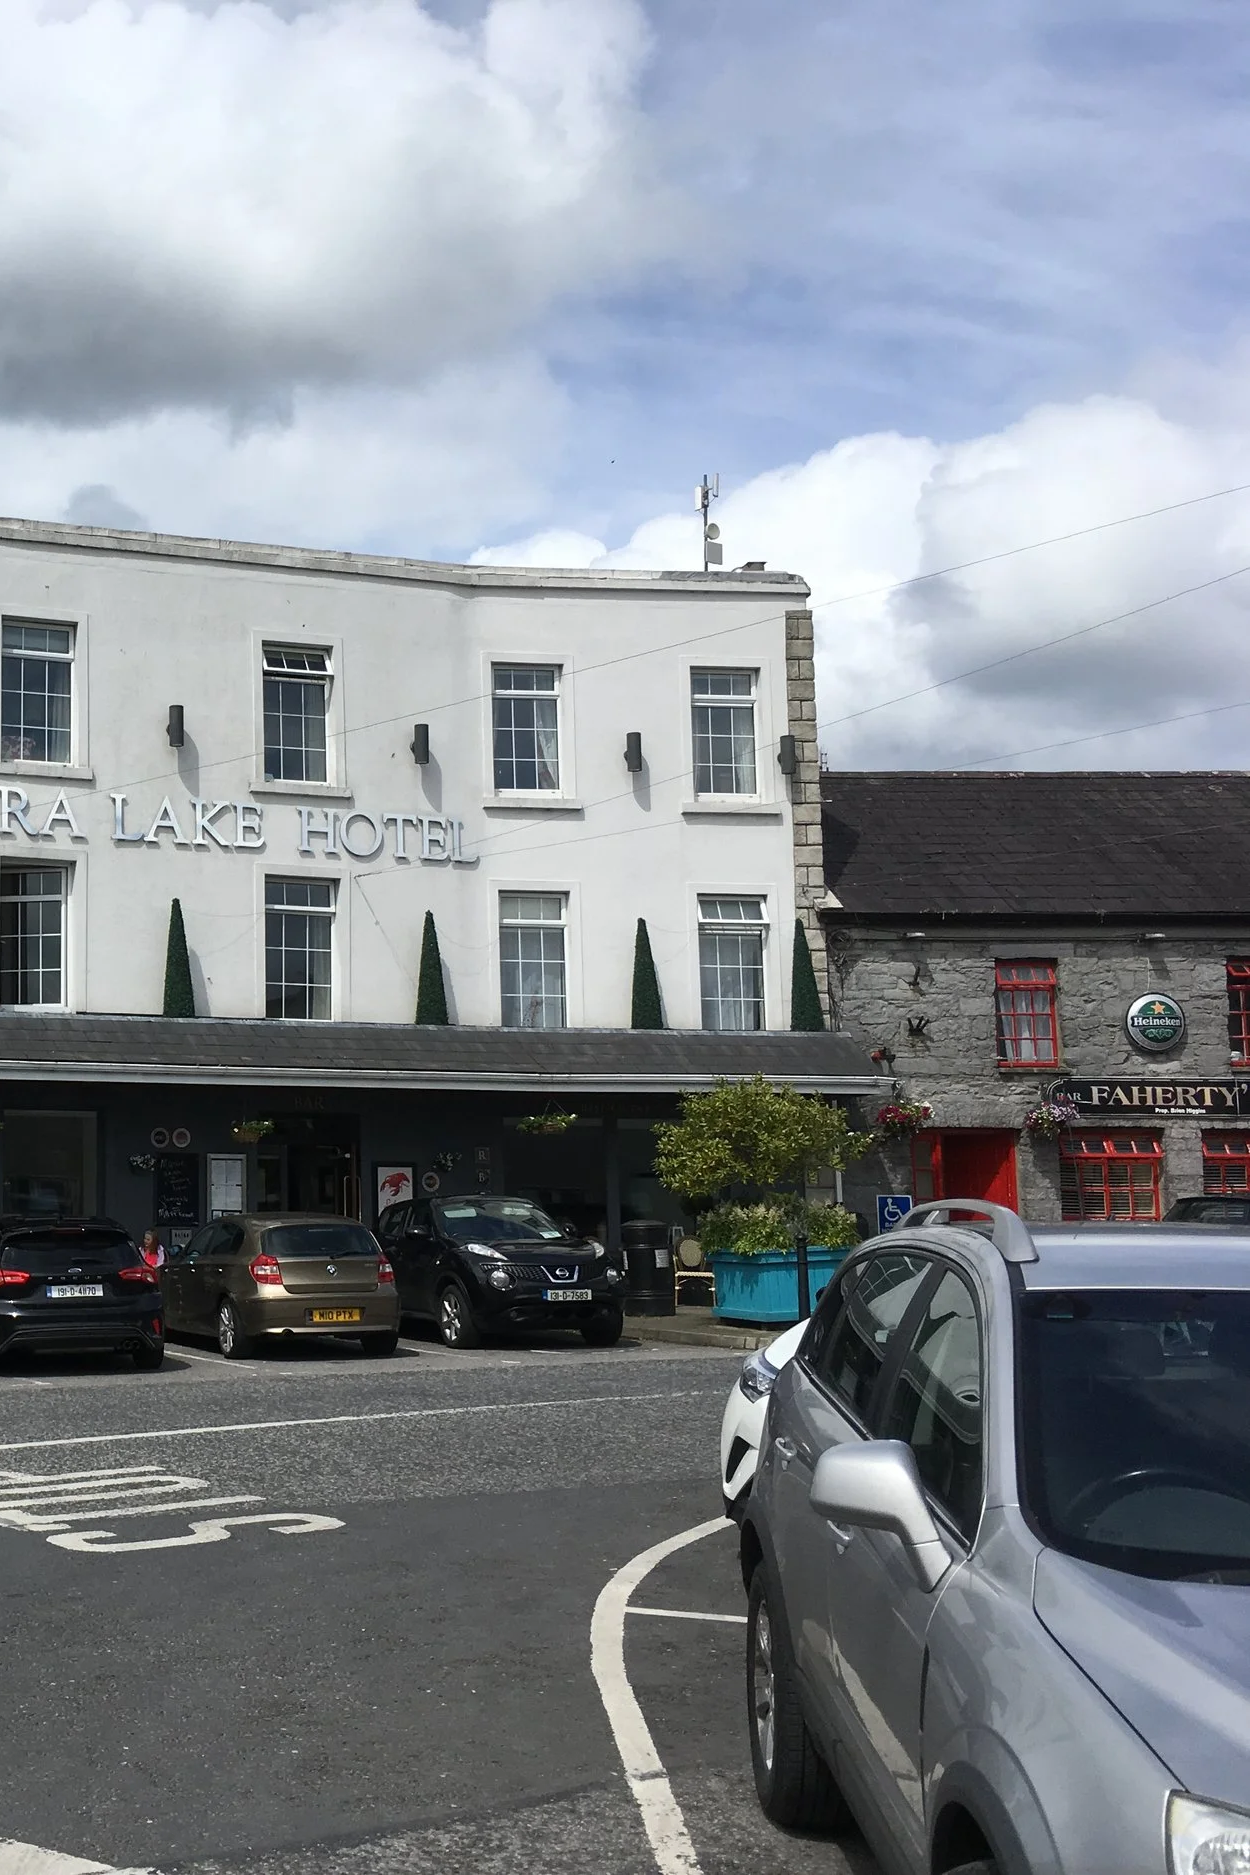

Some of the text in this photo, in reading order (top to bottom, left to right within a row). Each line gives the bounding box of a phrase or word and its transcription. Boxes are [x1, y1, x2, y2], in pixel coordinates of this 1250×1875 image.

[109, 793, 266, 848] LAKE
[295, 807, 479, 863] HOTEL
[1133, 1016, 1181, 1026] Heineken
